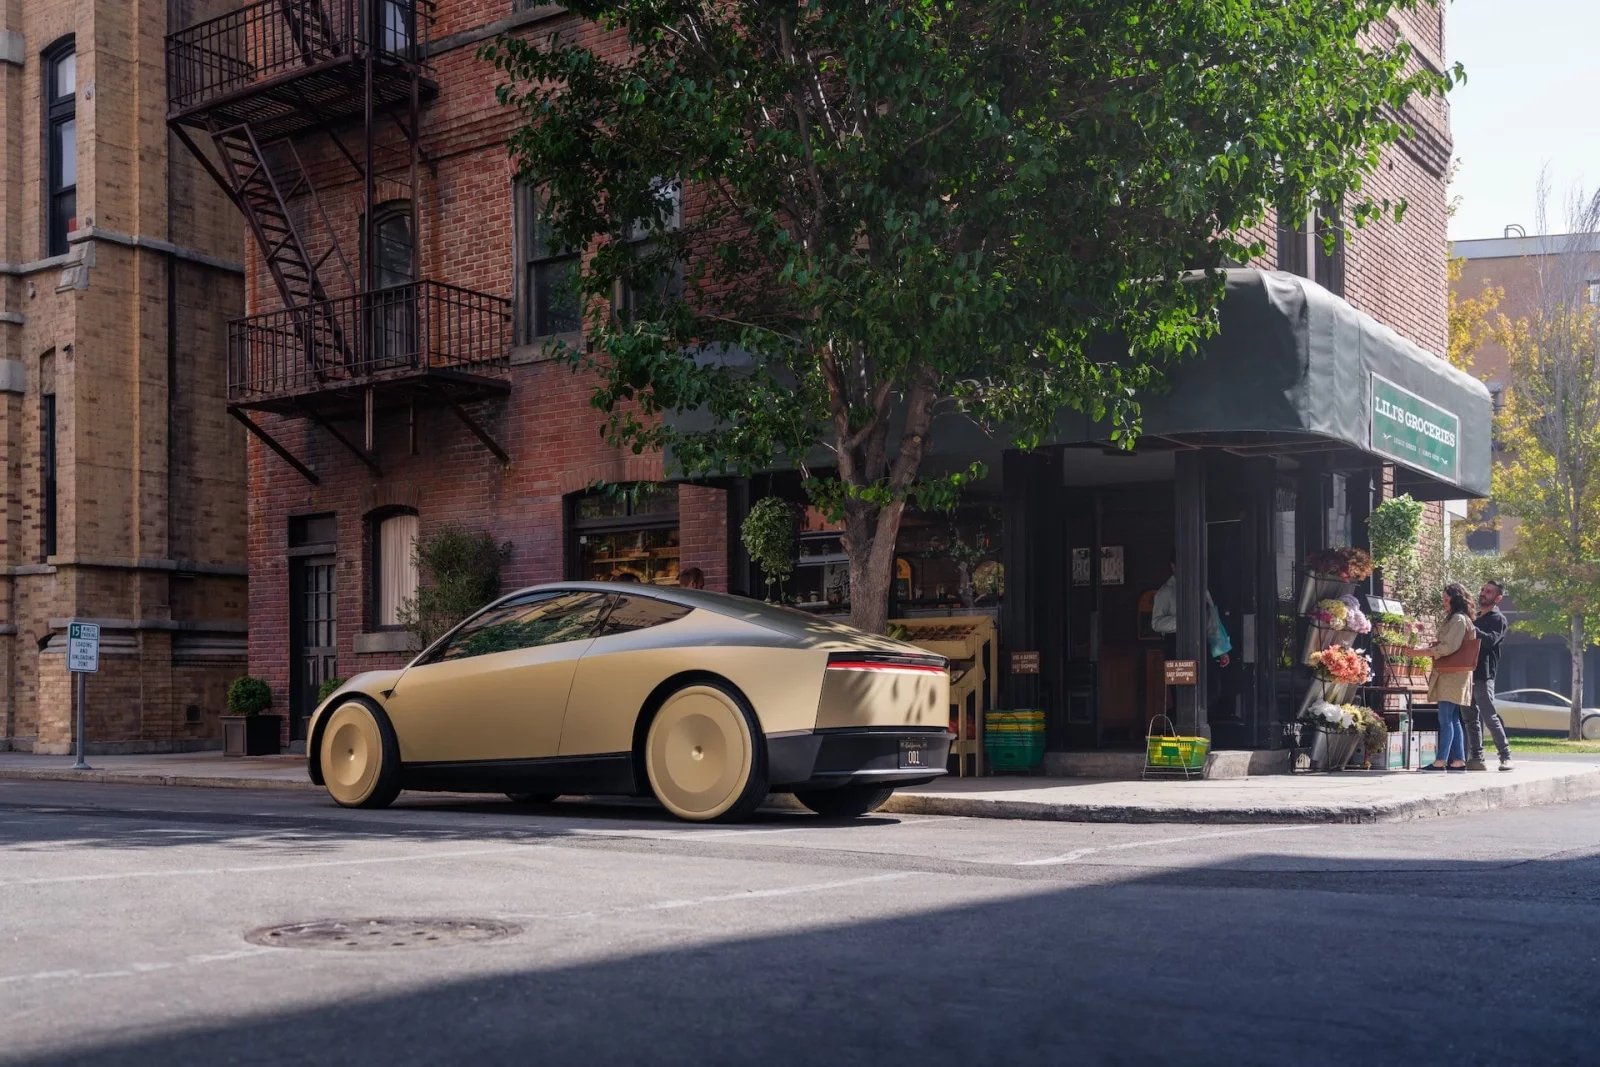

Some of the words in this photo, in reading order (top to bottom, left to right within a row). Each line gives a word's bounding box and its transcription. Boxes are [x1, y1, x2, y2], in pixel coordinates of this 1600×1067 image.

[1375, 396, 1404, 424] LILI'S
[1405, 411, 1455, 448] GROCERIES
[72, 625, 80, 637] 15
[908, 750, 920, 764] 001
